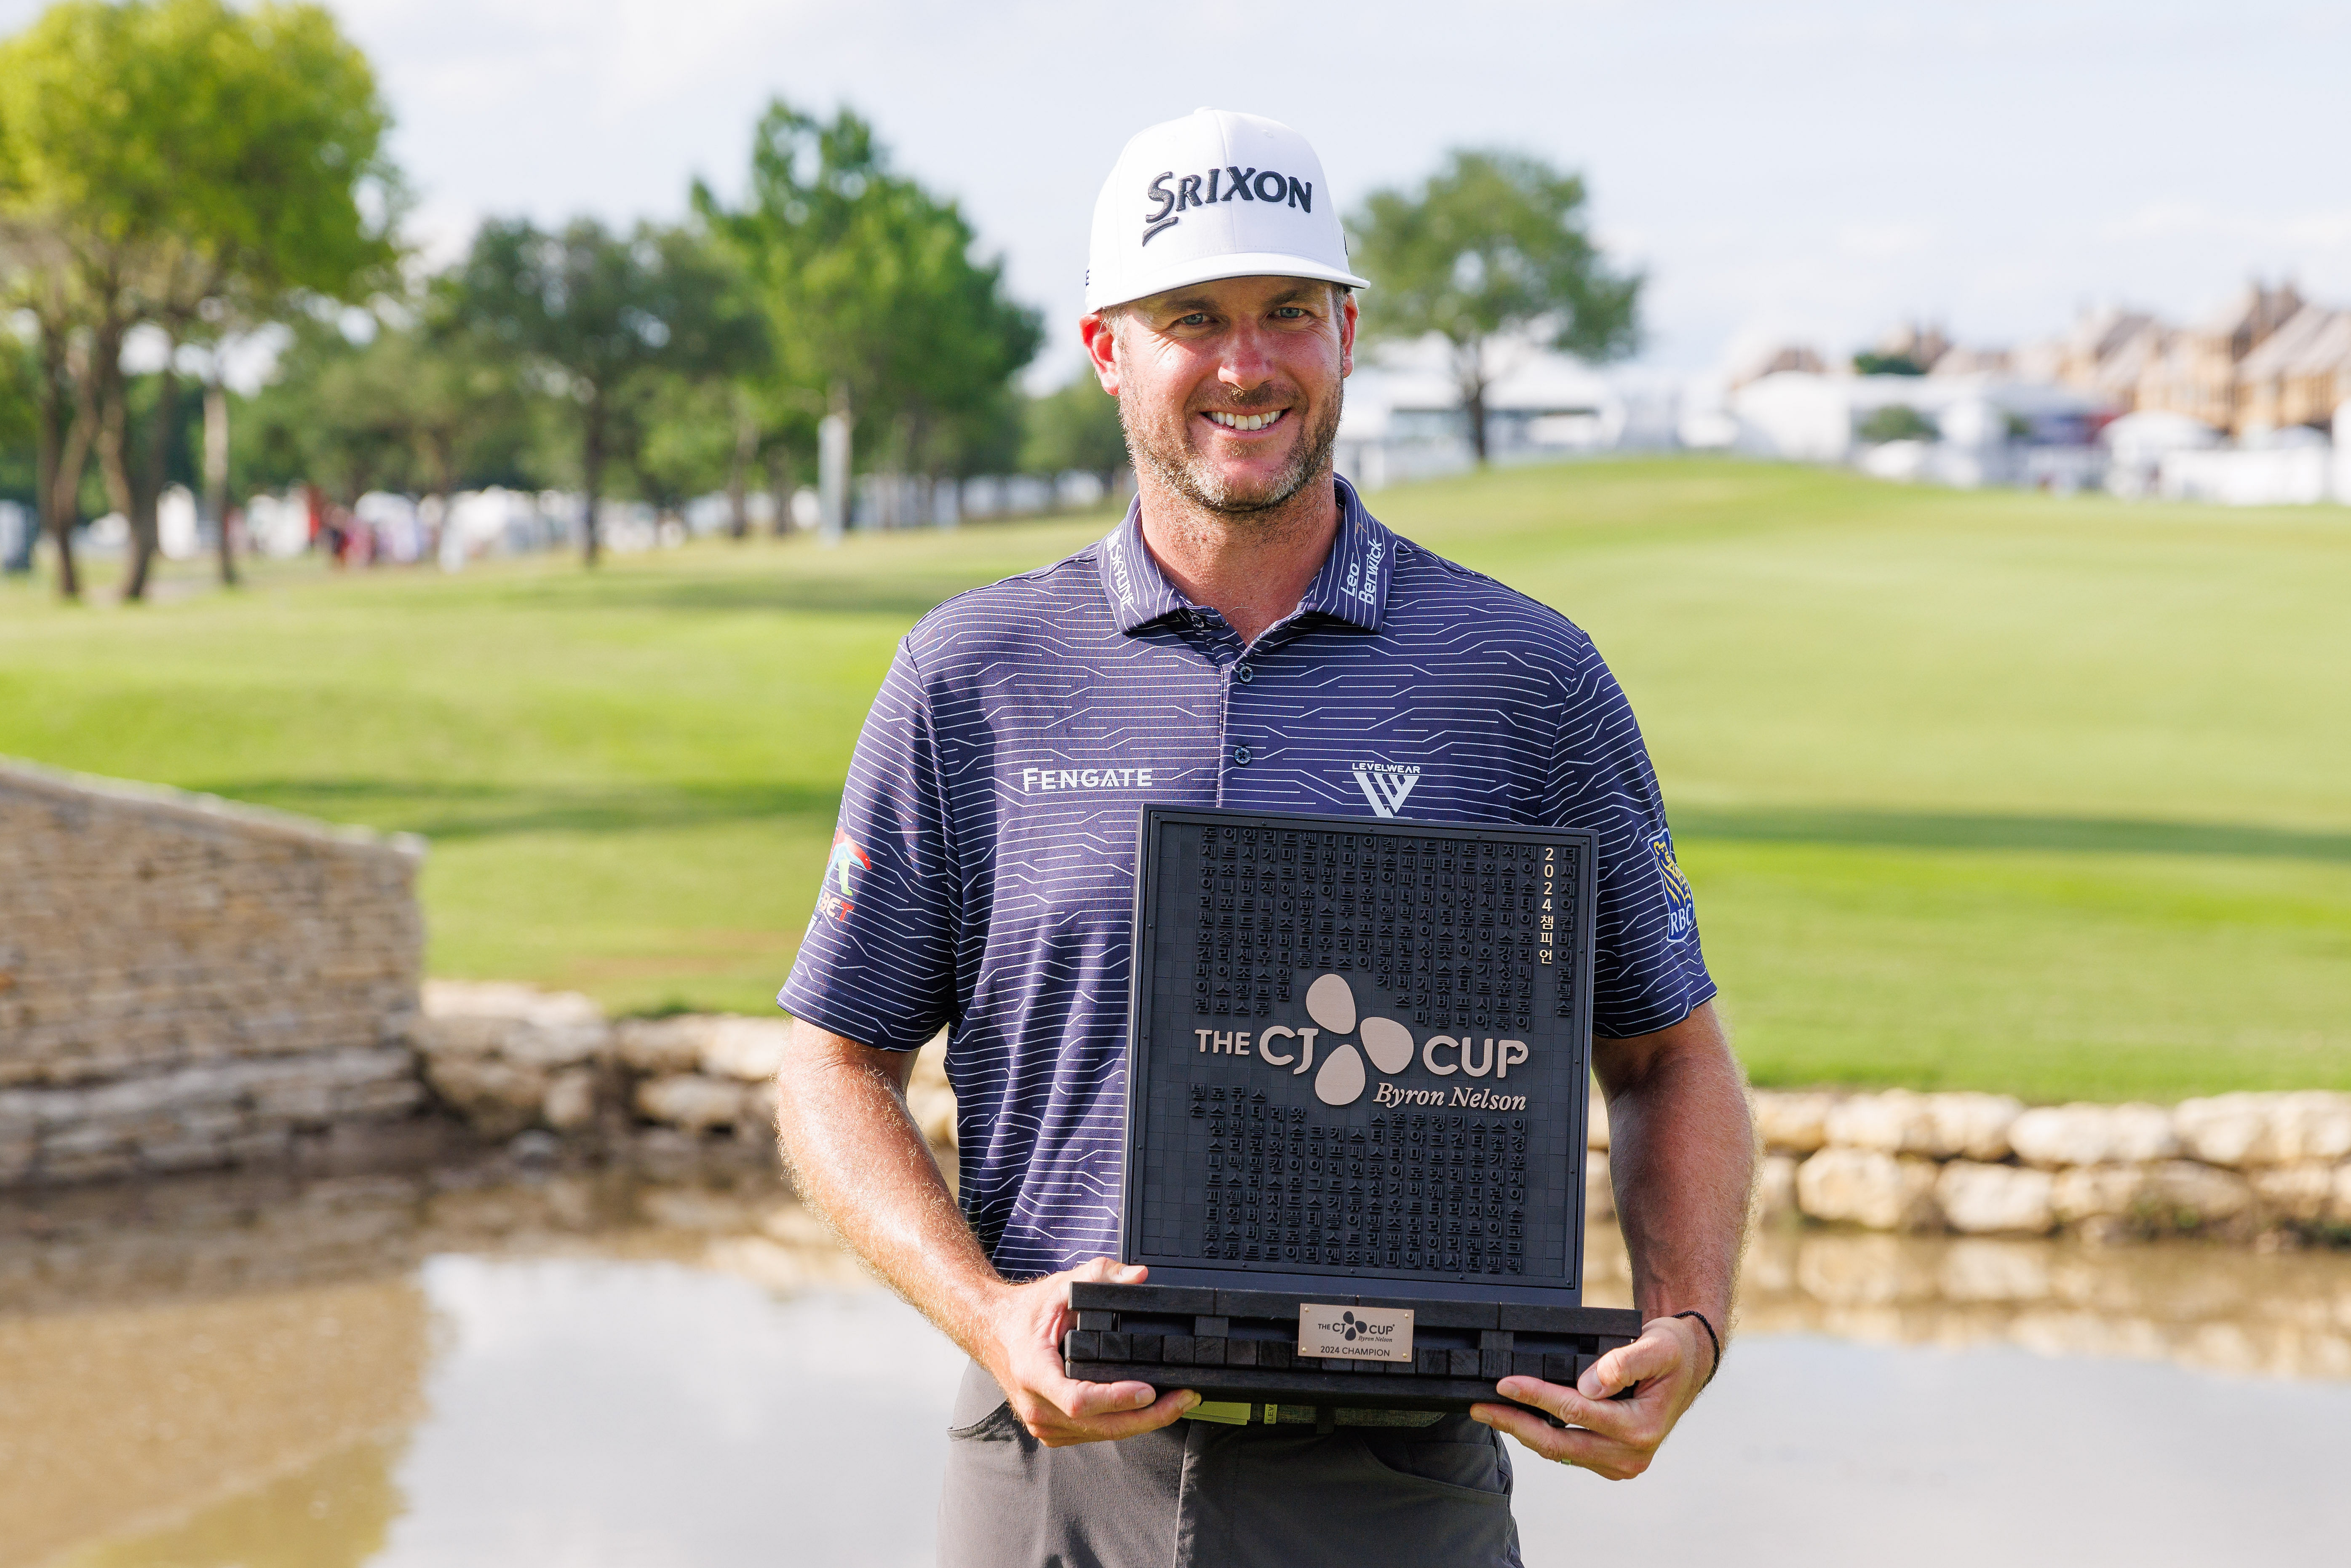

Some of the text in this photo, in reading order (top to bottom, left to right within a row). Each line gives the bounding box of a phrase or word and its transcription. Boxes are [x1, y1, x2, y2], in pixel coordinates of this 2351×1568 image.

[1143, 166, 1312, 224] SRIXON
[1112, 544, 1134, 611] SKYLINE
[1340, 563, 1359, 597] Leo
[1358, 538, 1382, 605] Berwick
[1023, 767, 1153, 792] FENGATE
[1352, 763, 1420, 774] LEVELWEAR
[1539, 848, 1553, 964] 2024챔피언
[1670, 903, 1692, 936] RBC
[1195, 1025, 1528, 1077] THE CJ CUP
[1375, 1083, 1525, 1111] Byron Nelson
[1332, 1323, 1346, 1334] CJ
[1342, 1347, 1390, 1356] CHAMPION
